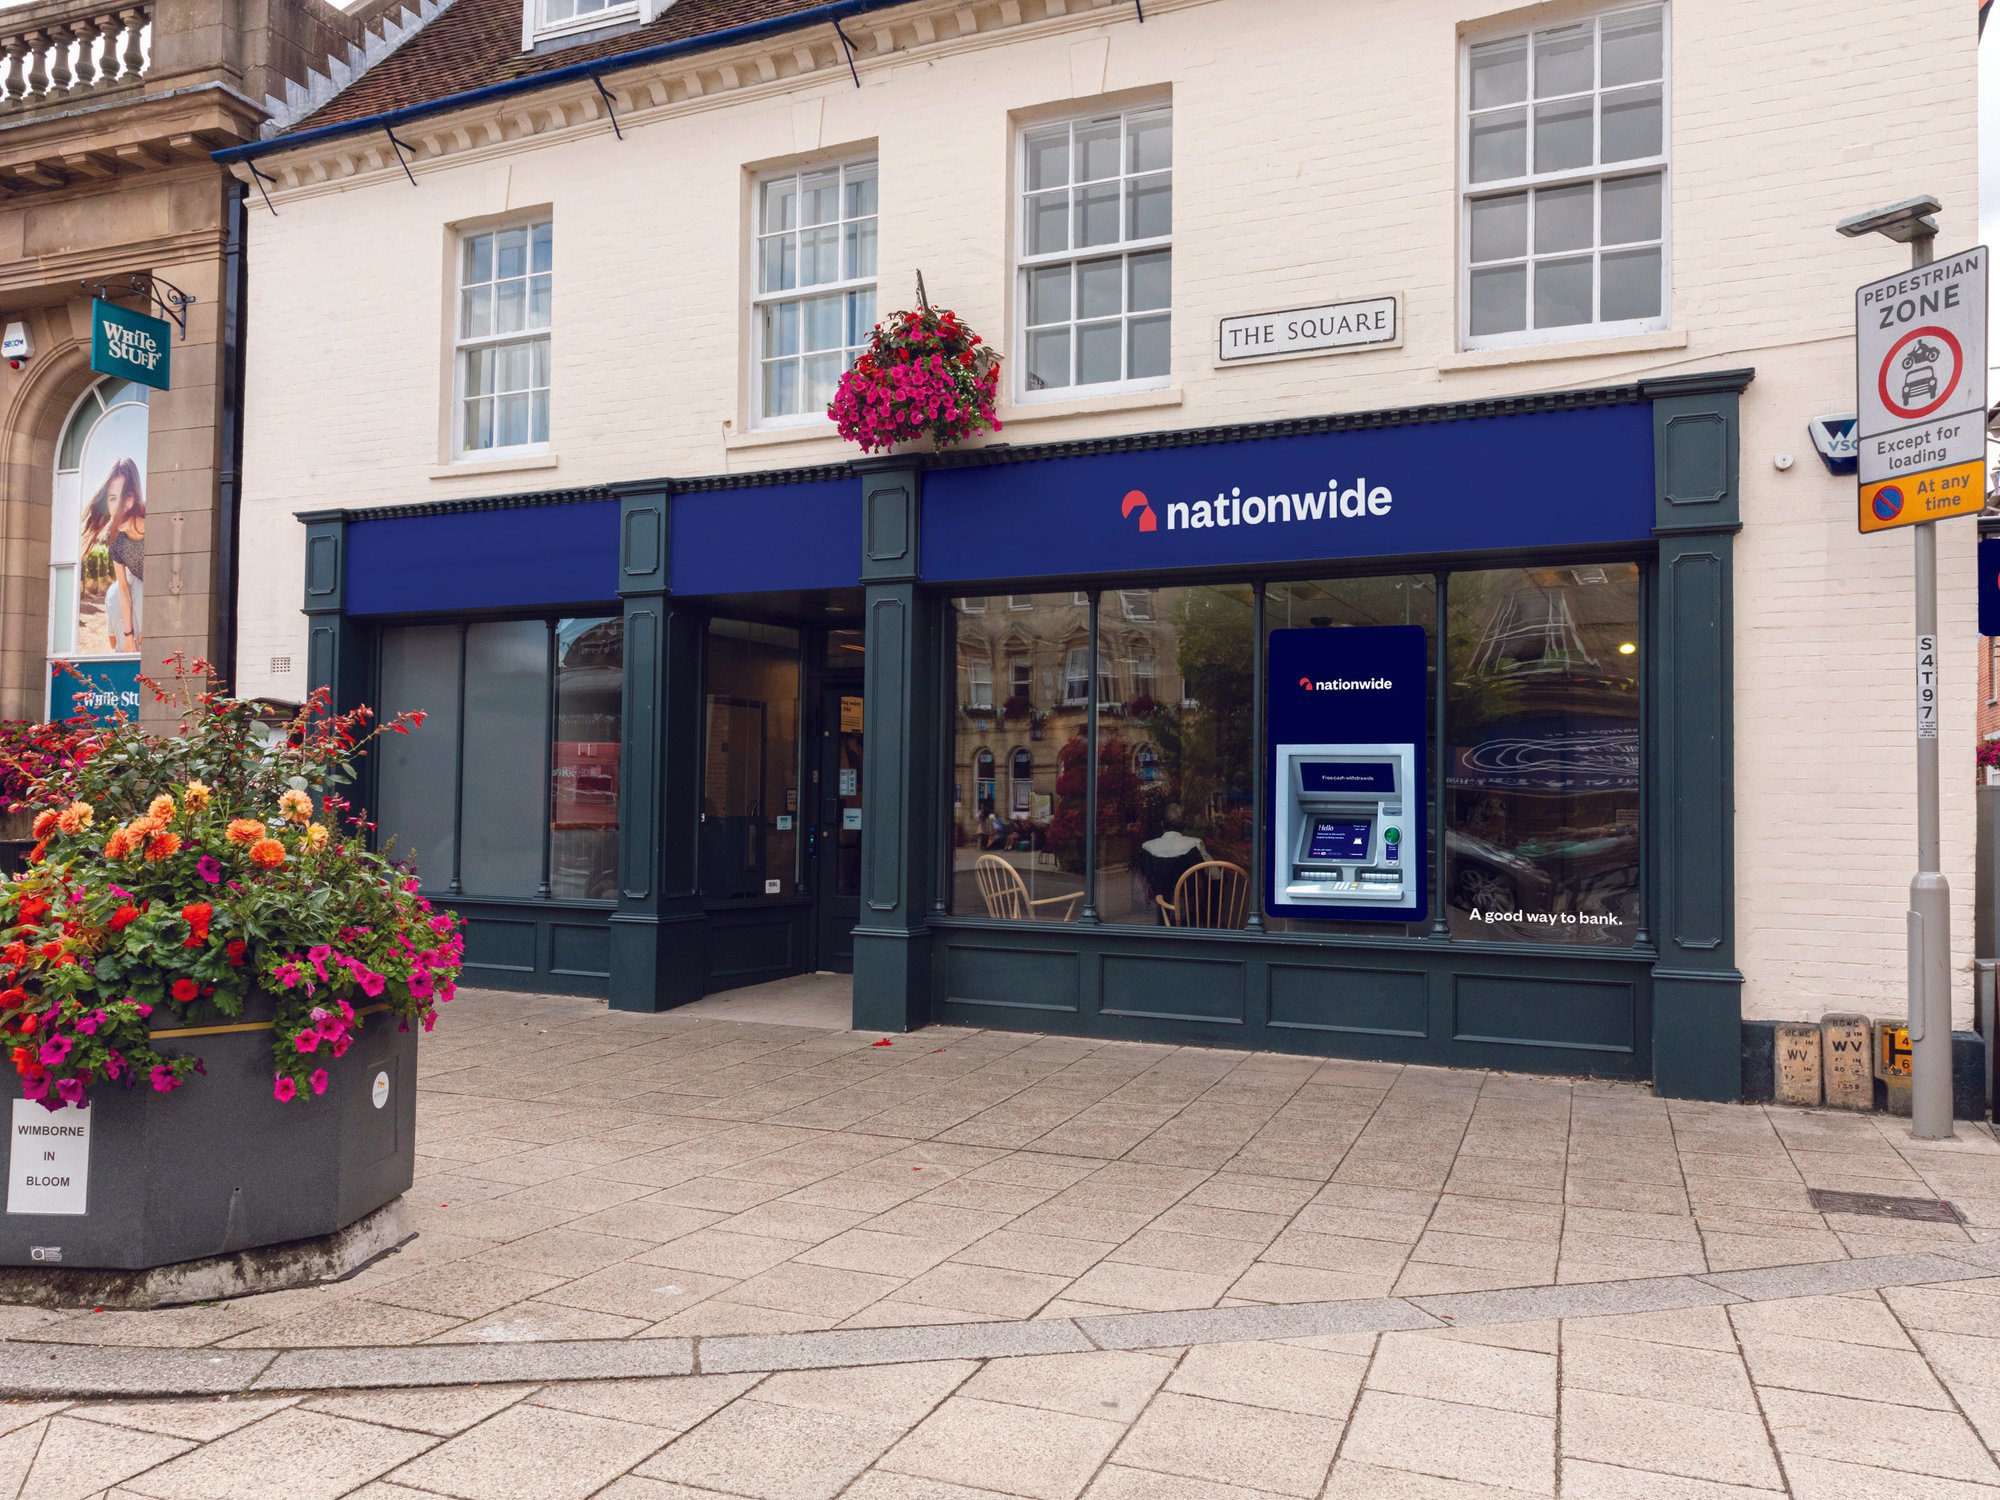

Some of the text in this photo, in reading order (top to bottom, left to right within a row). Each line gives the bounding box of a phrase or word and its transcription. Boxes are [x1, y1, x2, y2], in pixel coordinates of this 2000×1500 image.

[1864, 256, 1978, 306] PEDESTRIAN
[1879, 283, 1960, 330] ZONE
[1229, 310, 1387, 347] THE SQUARE
[1877, 425, 1961, 455] Except for
[1889, 447, 1947, 470] loading
[1917, 474, 1970, 495] At any
[1167, 477, 1393, 530] nationwide
[1925, 494, 1961, 511] time
[1315, 677, 1393, 691] nationwide
[1920, 637, 1934, 719] S4T97
[1318, 823, 1334, 832] Hello
[1469, 907, 1623, 926] A good way to bank.
[1902, 1037, 1910, 1047] 4
[1902, 1059, 1910, 1069] 6
[18, 1125, 84, 1136] WIMBORNE
[43, 1151, 55, 1161] IN
[26, 1176, 70, 1187] BLOOM
